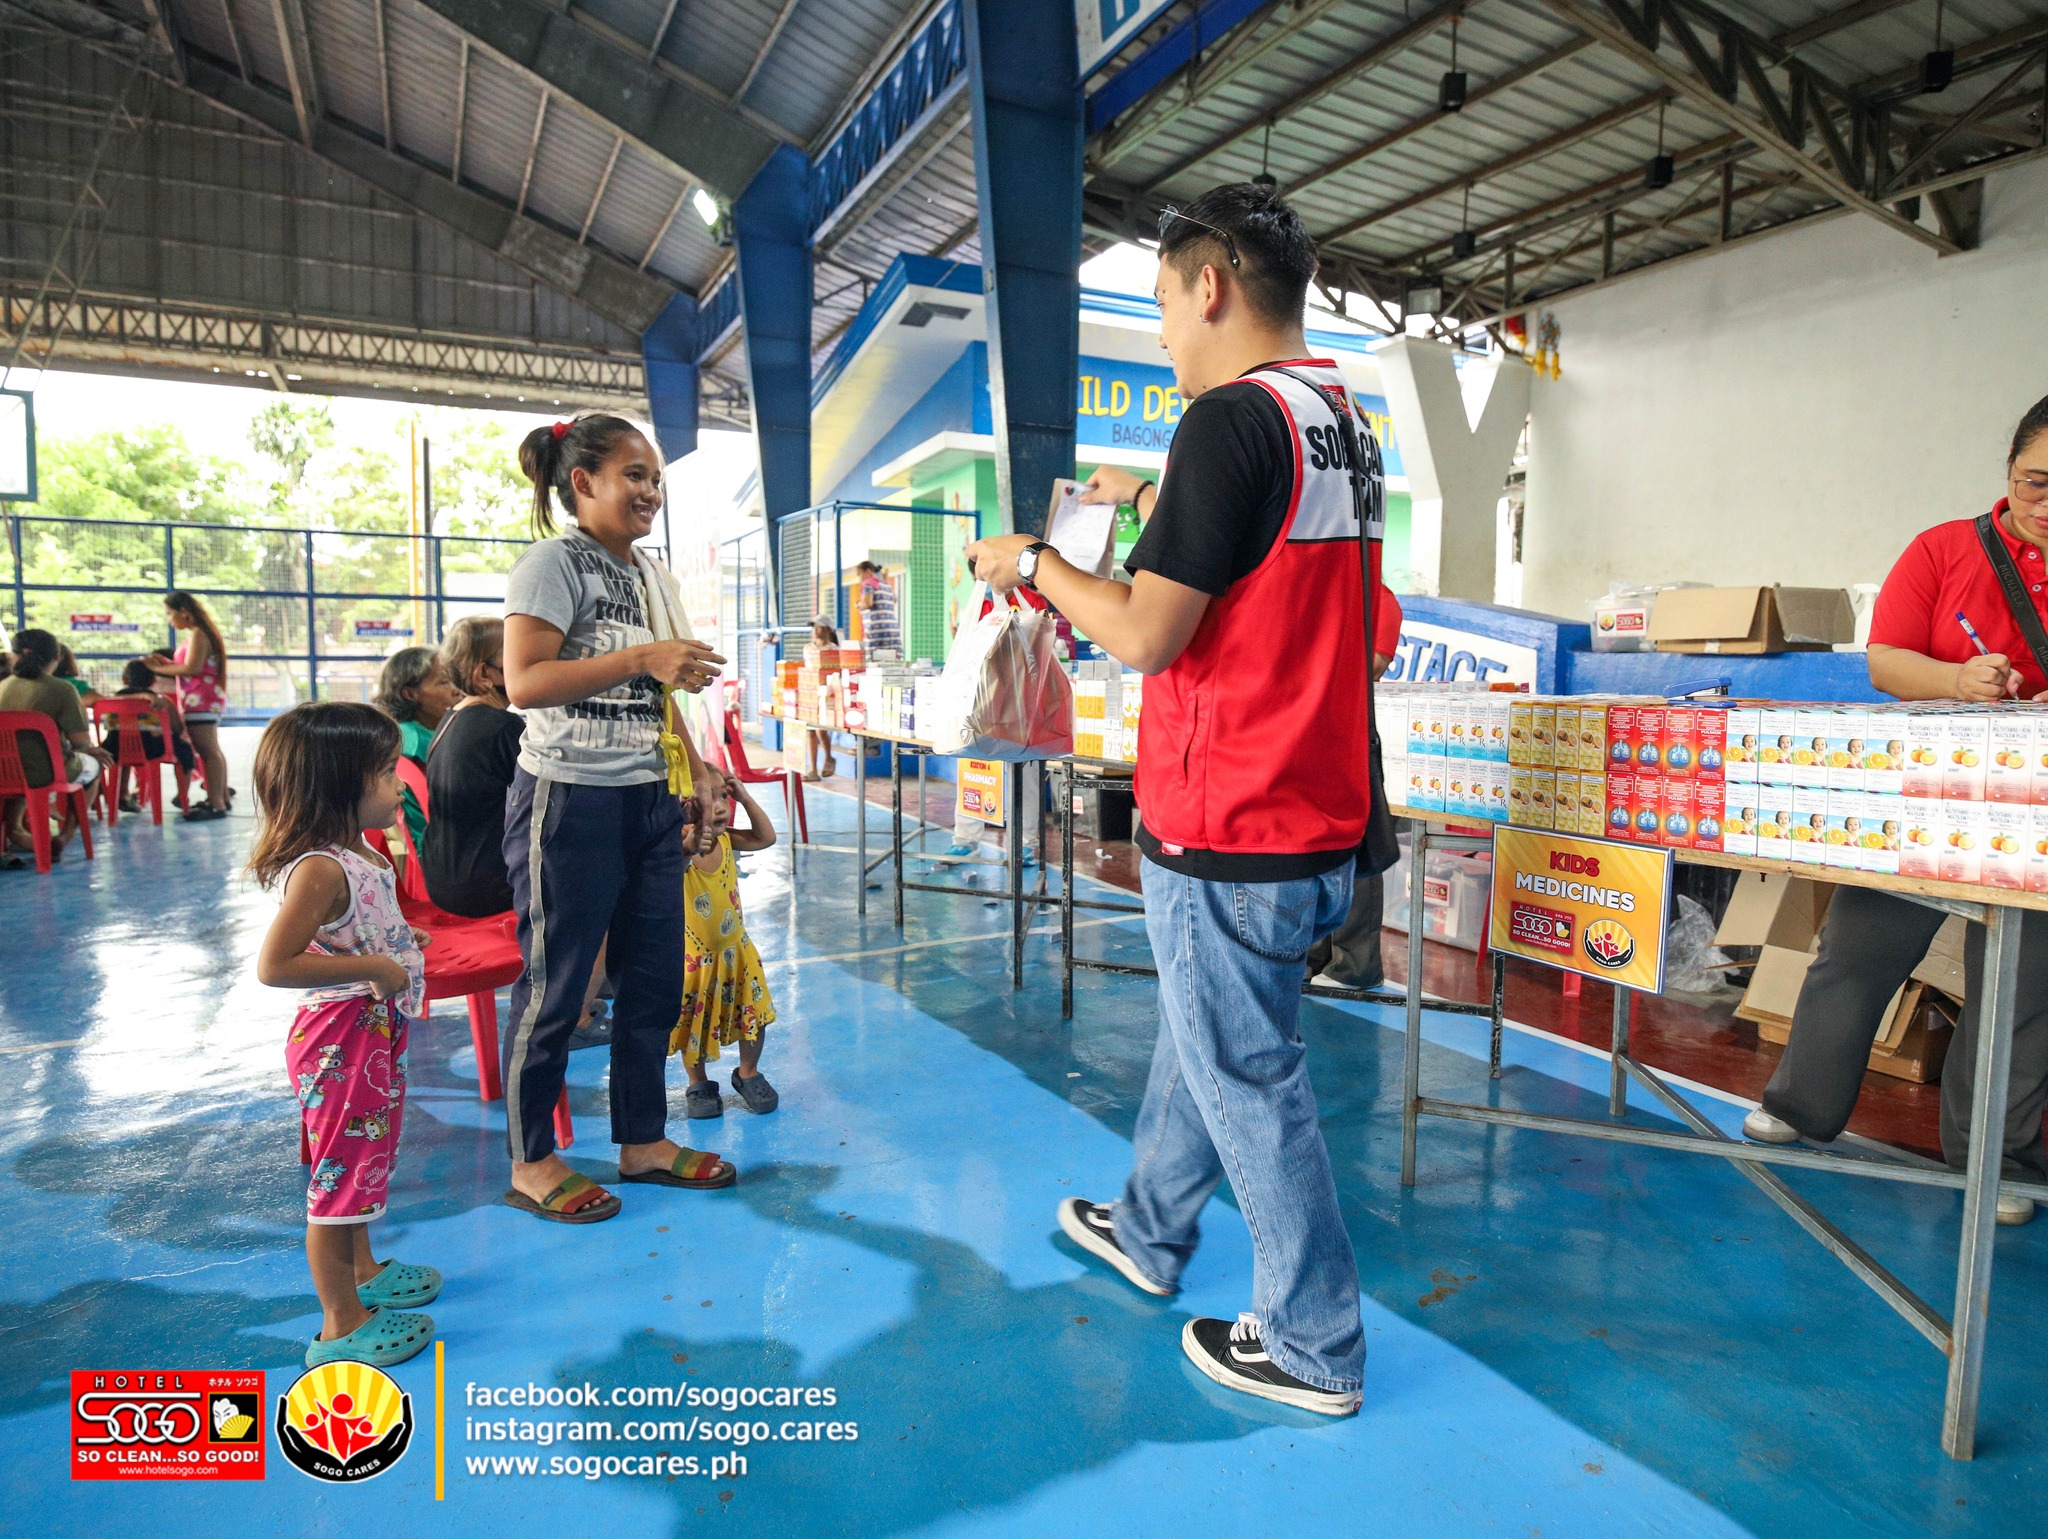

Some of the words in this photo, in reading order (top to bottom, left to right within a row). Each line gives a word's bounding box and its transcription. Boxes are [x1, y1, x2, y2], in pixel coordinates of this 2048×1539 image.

[1112, 423, 1173, 449] BAGONG
[1999, 564, 2025, 608] MICHAELA
[571, 718, 608, 749] ON
[963, 771, 997, 787] PHARMACY
[1549, 851, 1600, 877] KIDS
[1515, 871, 1636, 913] MEDICINES
[1513, 910, 1553, 935] SOGO
[1519, 905, 1548, 915] HOTEL
[1552, 939, 1571, 948] GOOD!
